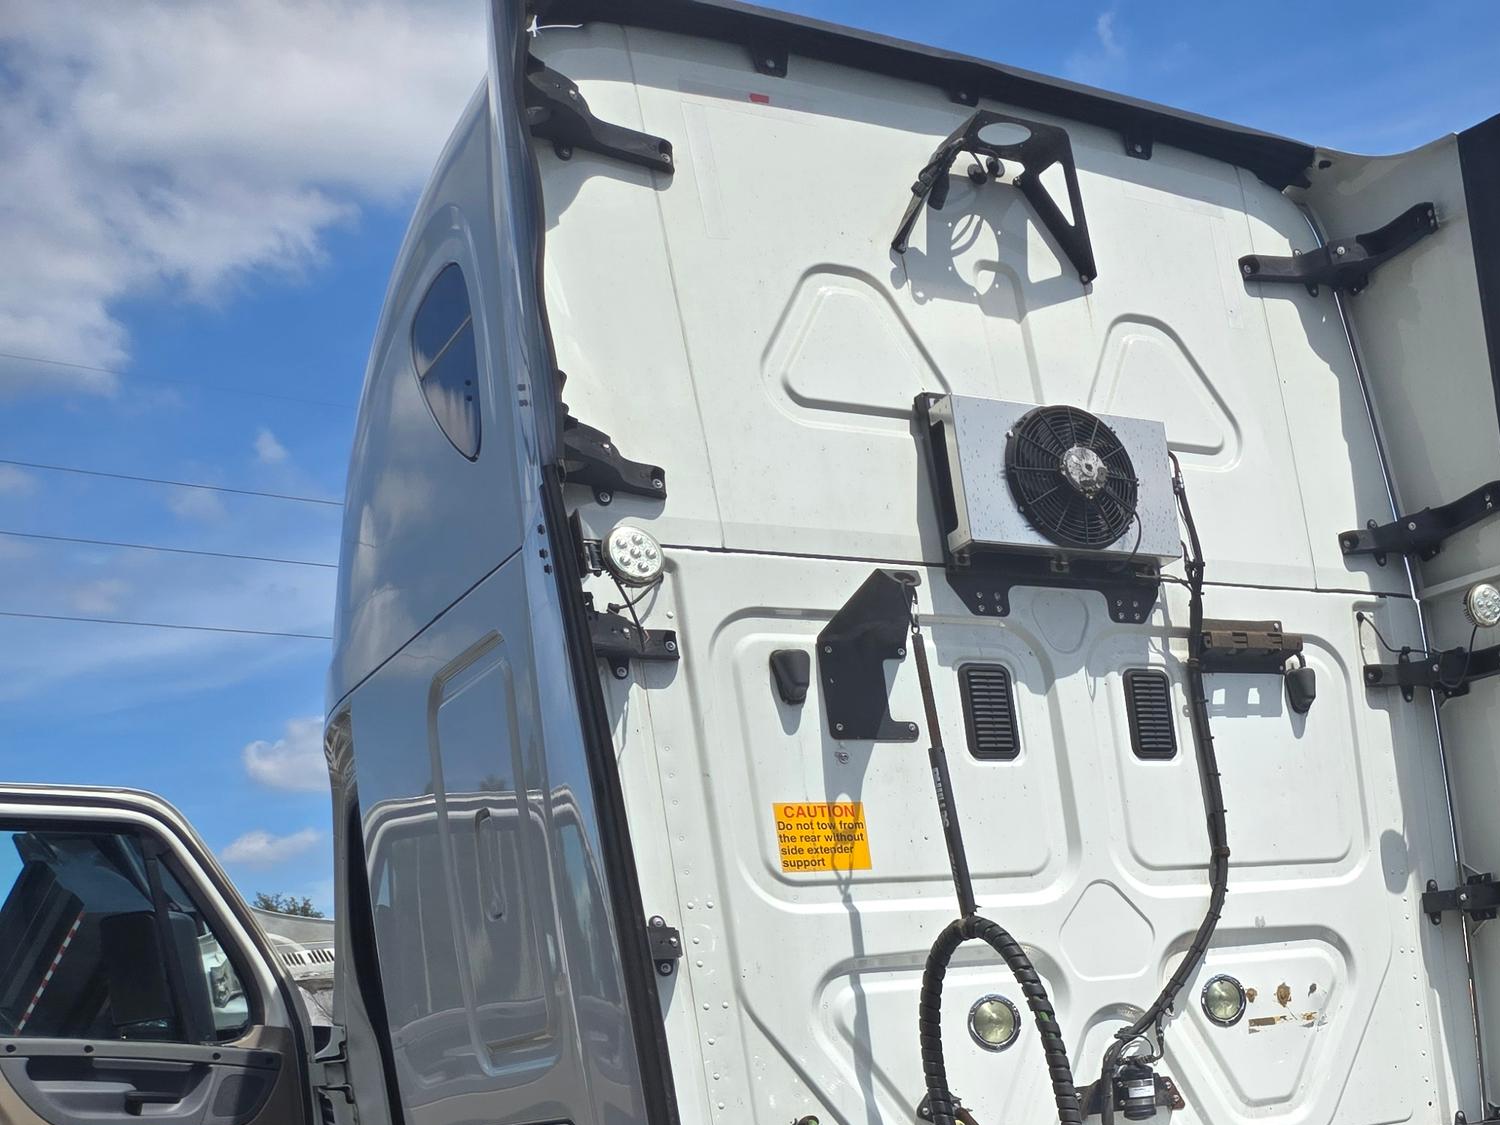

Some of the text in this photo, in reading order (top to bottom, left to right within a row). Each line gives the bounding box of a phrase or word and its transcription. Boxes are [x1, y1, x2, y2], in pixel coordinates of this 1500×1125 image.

[783, 804, 856, 819] CAUTION
[777, 819, 864, 831] Do not tow from
[779, 832, 864, 843] the rear without
[781, 844, 854, 855] side extender
[782, 858, 826, 869] support
